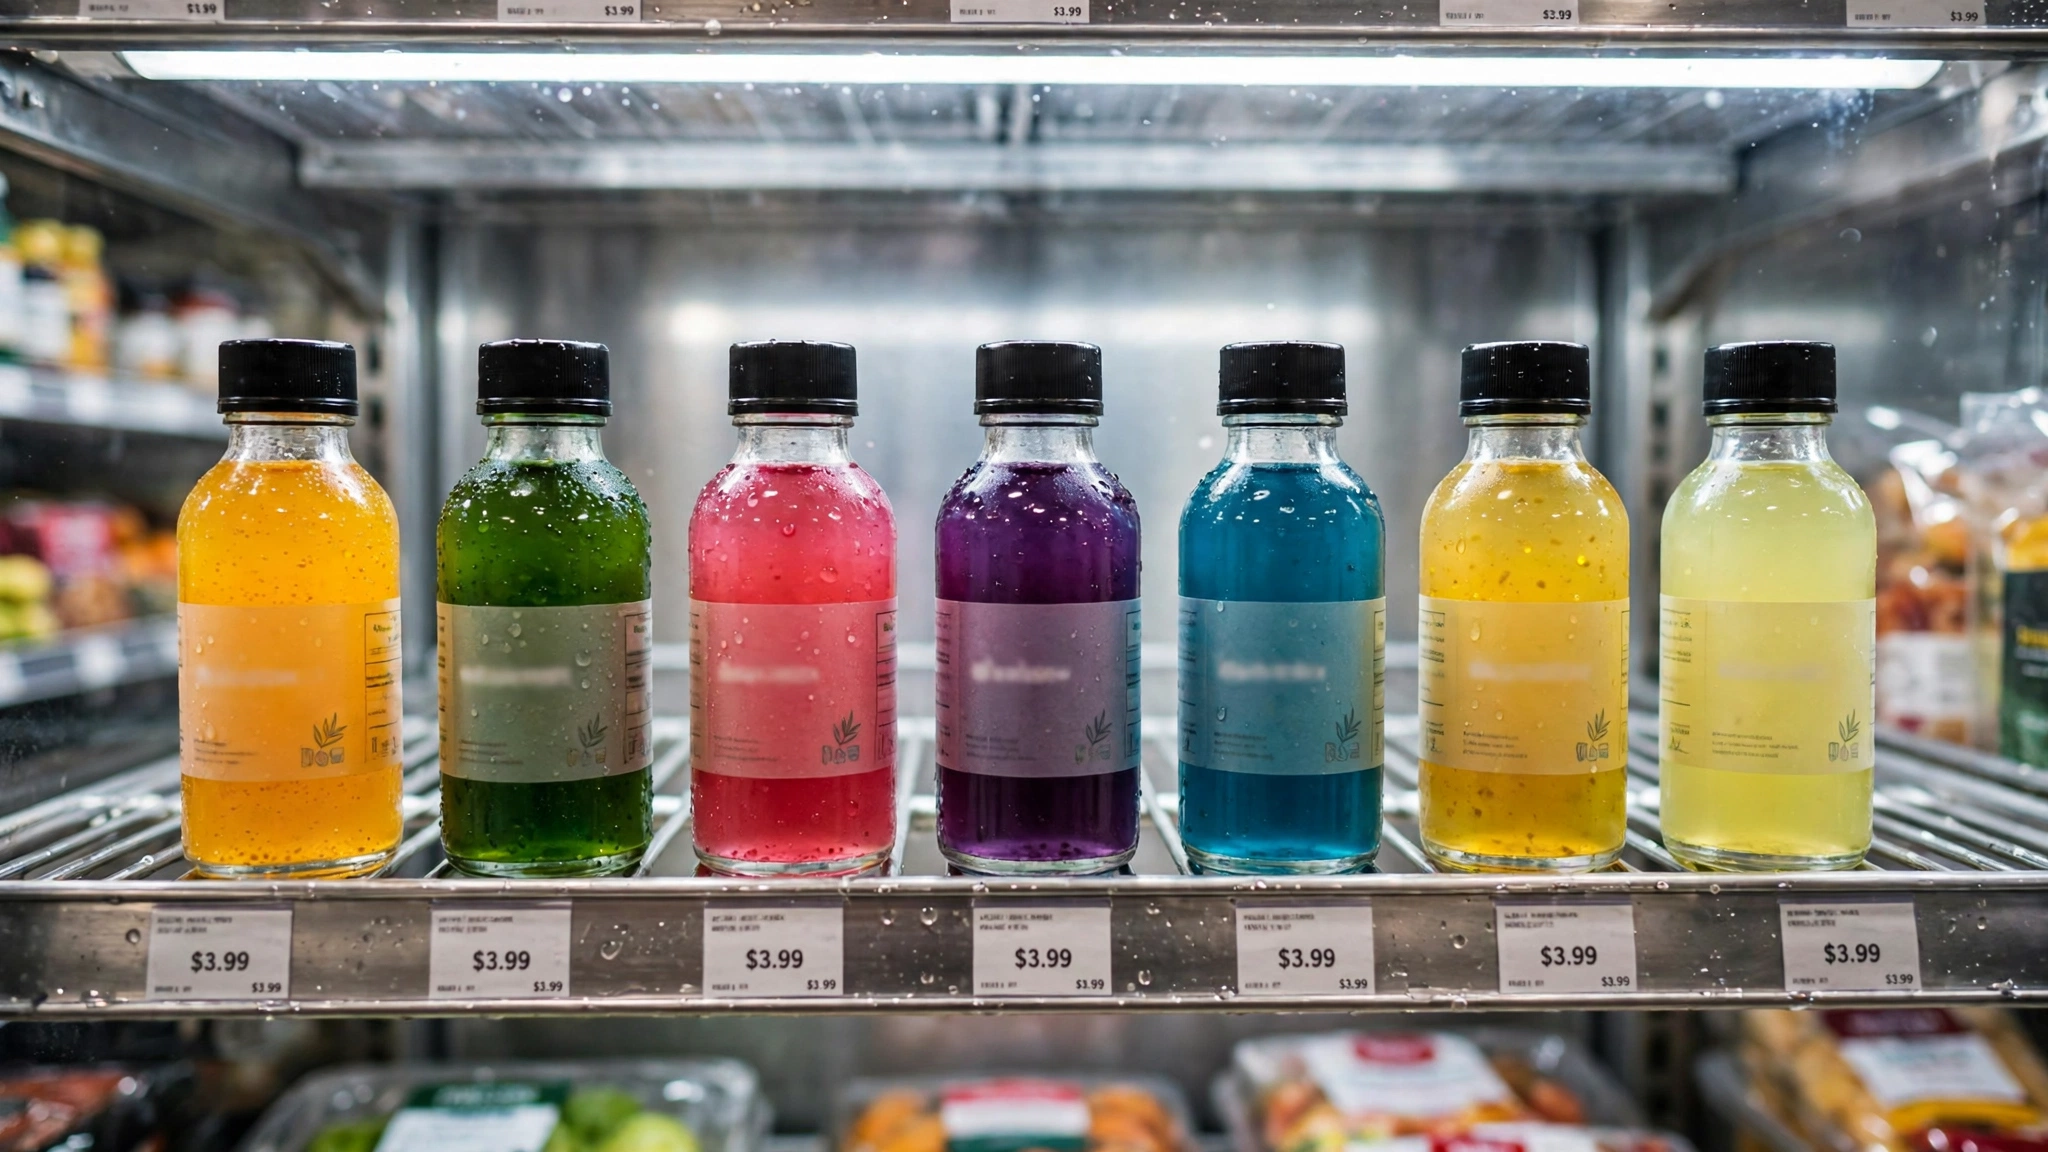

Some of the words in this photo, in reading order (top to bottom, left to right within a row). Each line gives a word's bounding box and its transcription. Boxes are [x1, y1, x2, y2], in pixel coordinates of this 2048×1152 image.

[1054, 7, 1081, 16] $3.99
[1543, 10, 1572, 20] $3.99
[1951, 11, 1978, 21] $3.99
[746, 949, 803, 970] $3.99
[1015, 948, 1072, 969] $3.99
[1279, 948, 1335, 969] $3.99
[1541, 946, 1597, 967] $3.99
[1824, 943, 1880, 965] $3.99
[191, 951, 249, 973] $3.99
[473, 950, 530, 972] $3.99
[807, 979, 836, 990] $3.99
[1076, 979, 1104, 989] $3.99
[1340, 979, 1367, 989] $3.99
[1602, 976, 1630, 987] $3.99
[1886, 974, 1913, 984] $3.99
[252, 982, 281, 993] $3.99
[534, 981, 563, 992] $3.99
